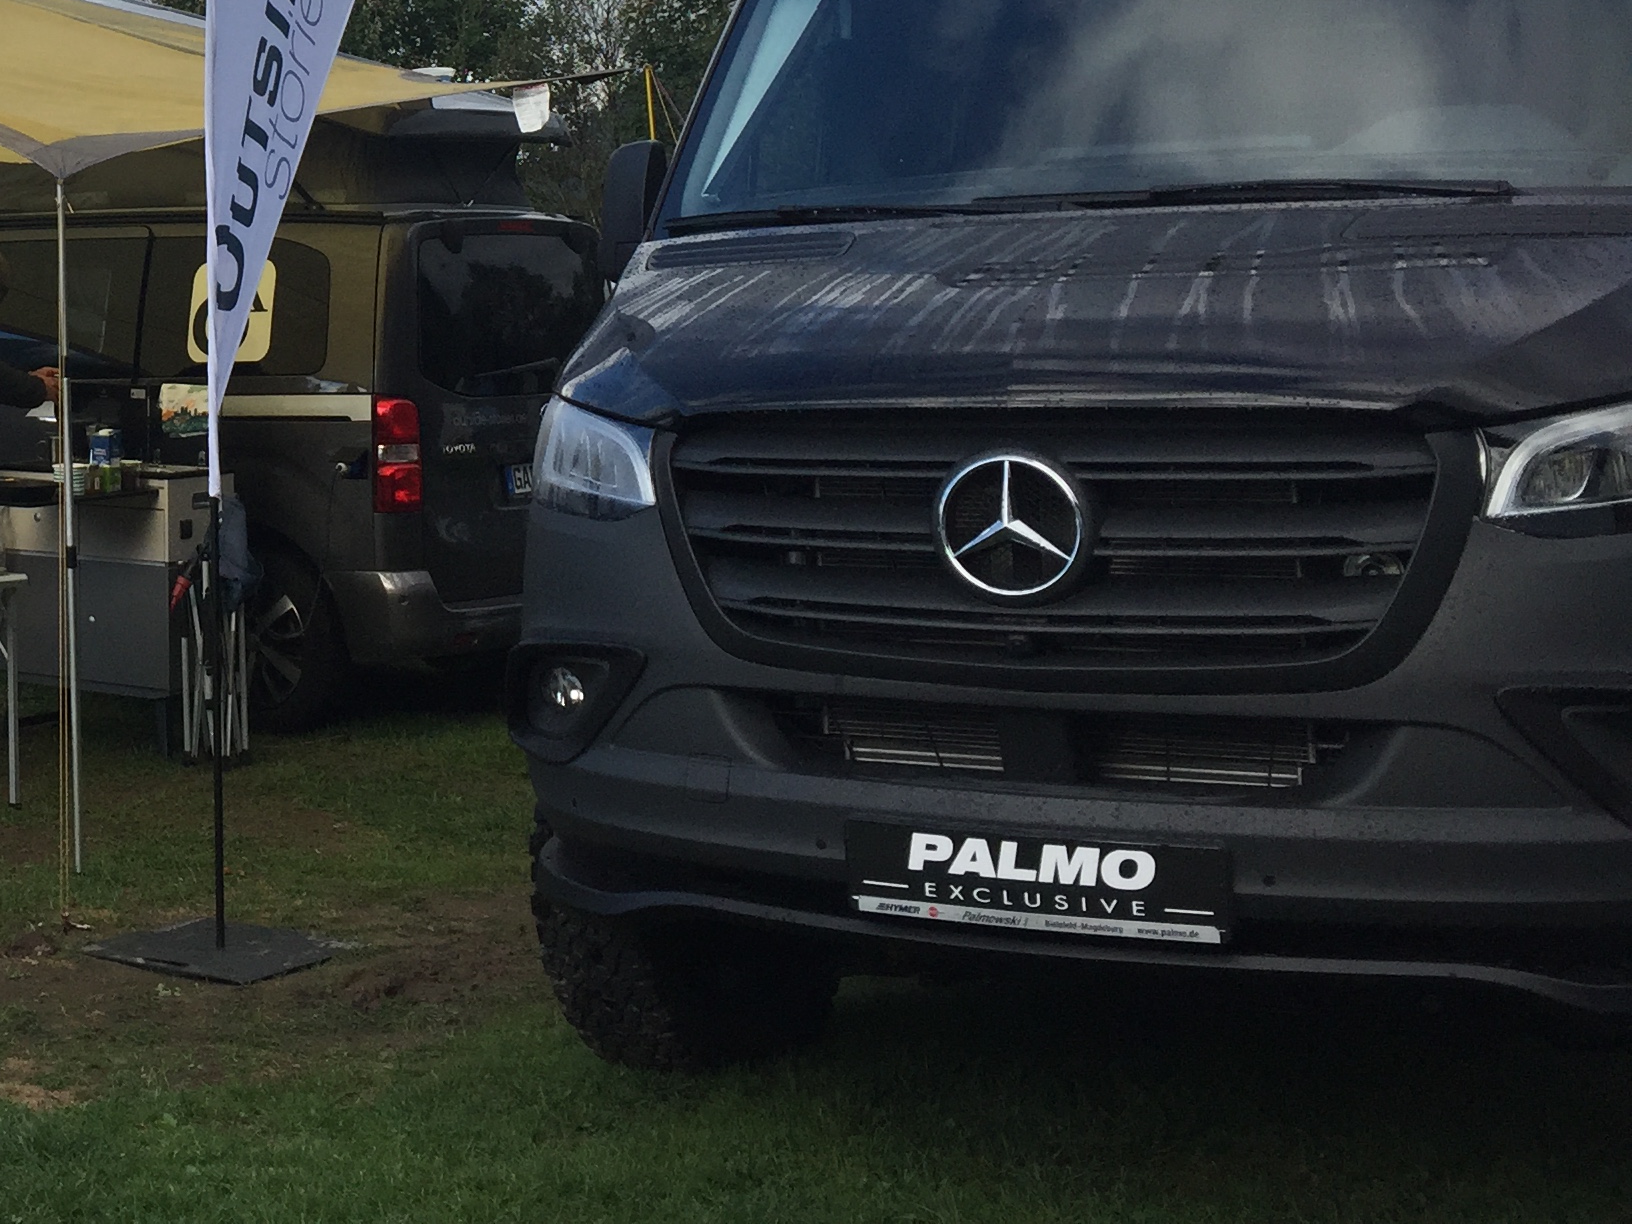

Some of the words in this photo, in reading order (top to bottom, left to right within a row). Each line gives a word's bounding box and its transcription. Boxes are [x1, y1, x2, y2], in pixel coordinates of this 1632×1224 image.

[442, 443, 476, 455] TOYOTA
[907, 832, 1156, 891] PALMO
[924, 881, 1146, 917] EXCLUSIVE
